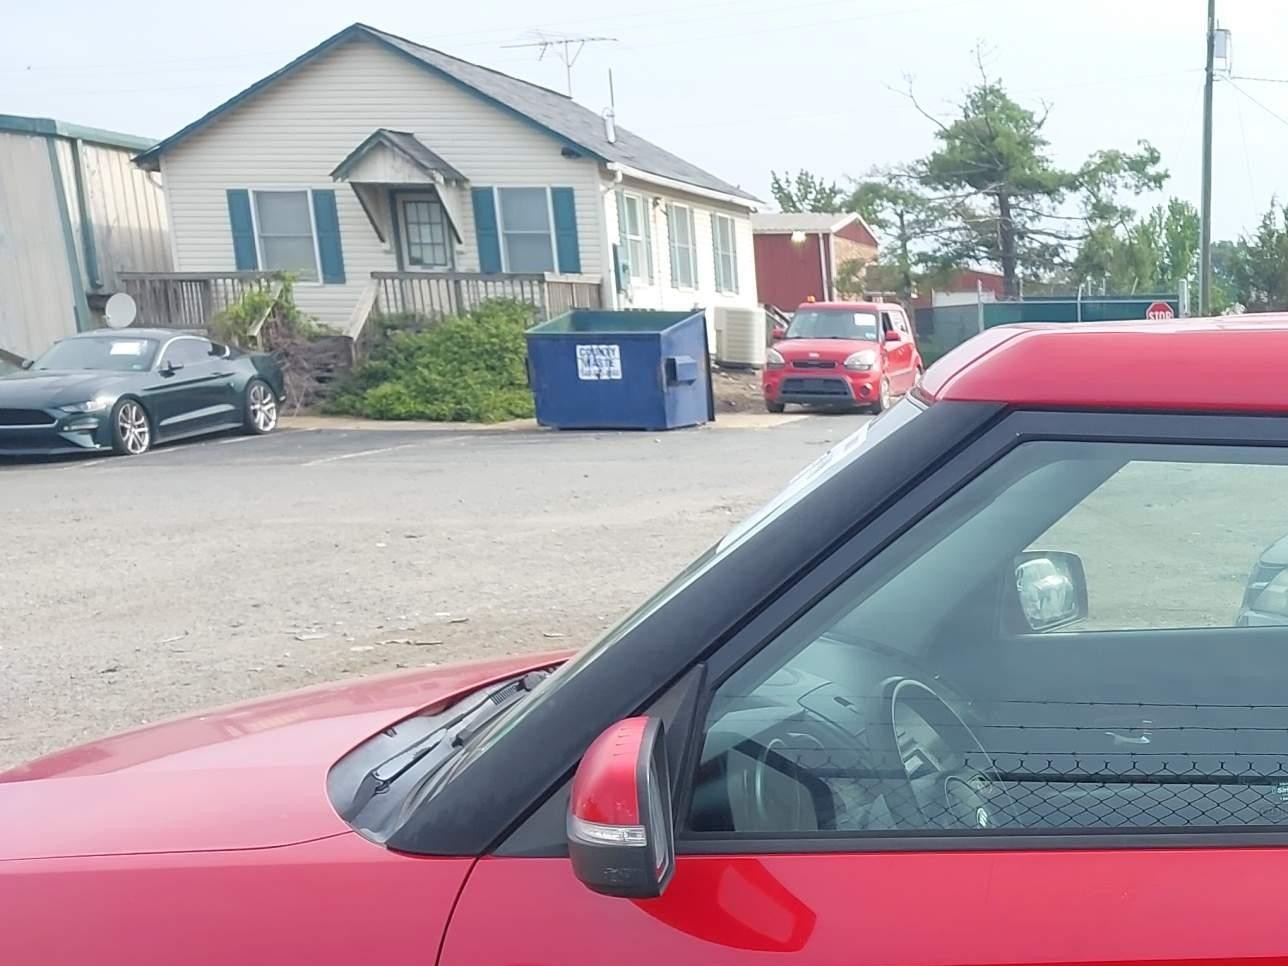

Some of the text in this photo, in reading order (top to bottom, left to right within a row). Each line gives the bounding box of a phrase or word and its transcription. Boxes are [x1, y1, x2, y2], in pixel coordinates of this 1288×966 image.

[1149, 310, 1171, 320] STOP
[578, 347, 616, 358] COUNTY
[579, 358, 615, 368] WASTE
